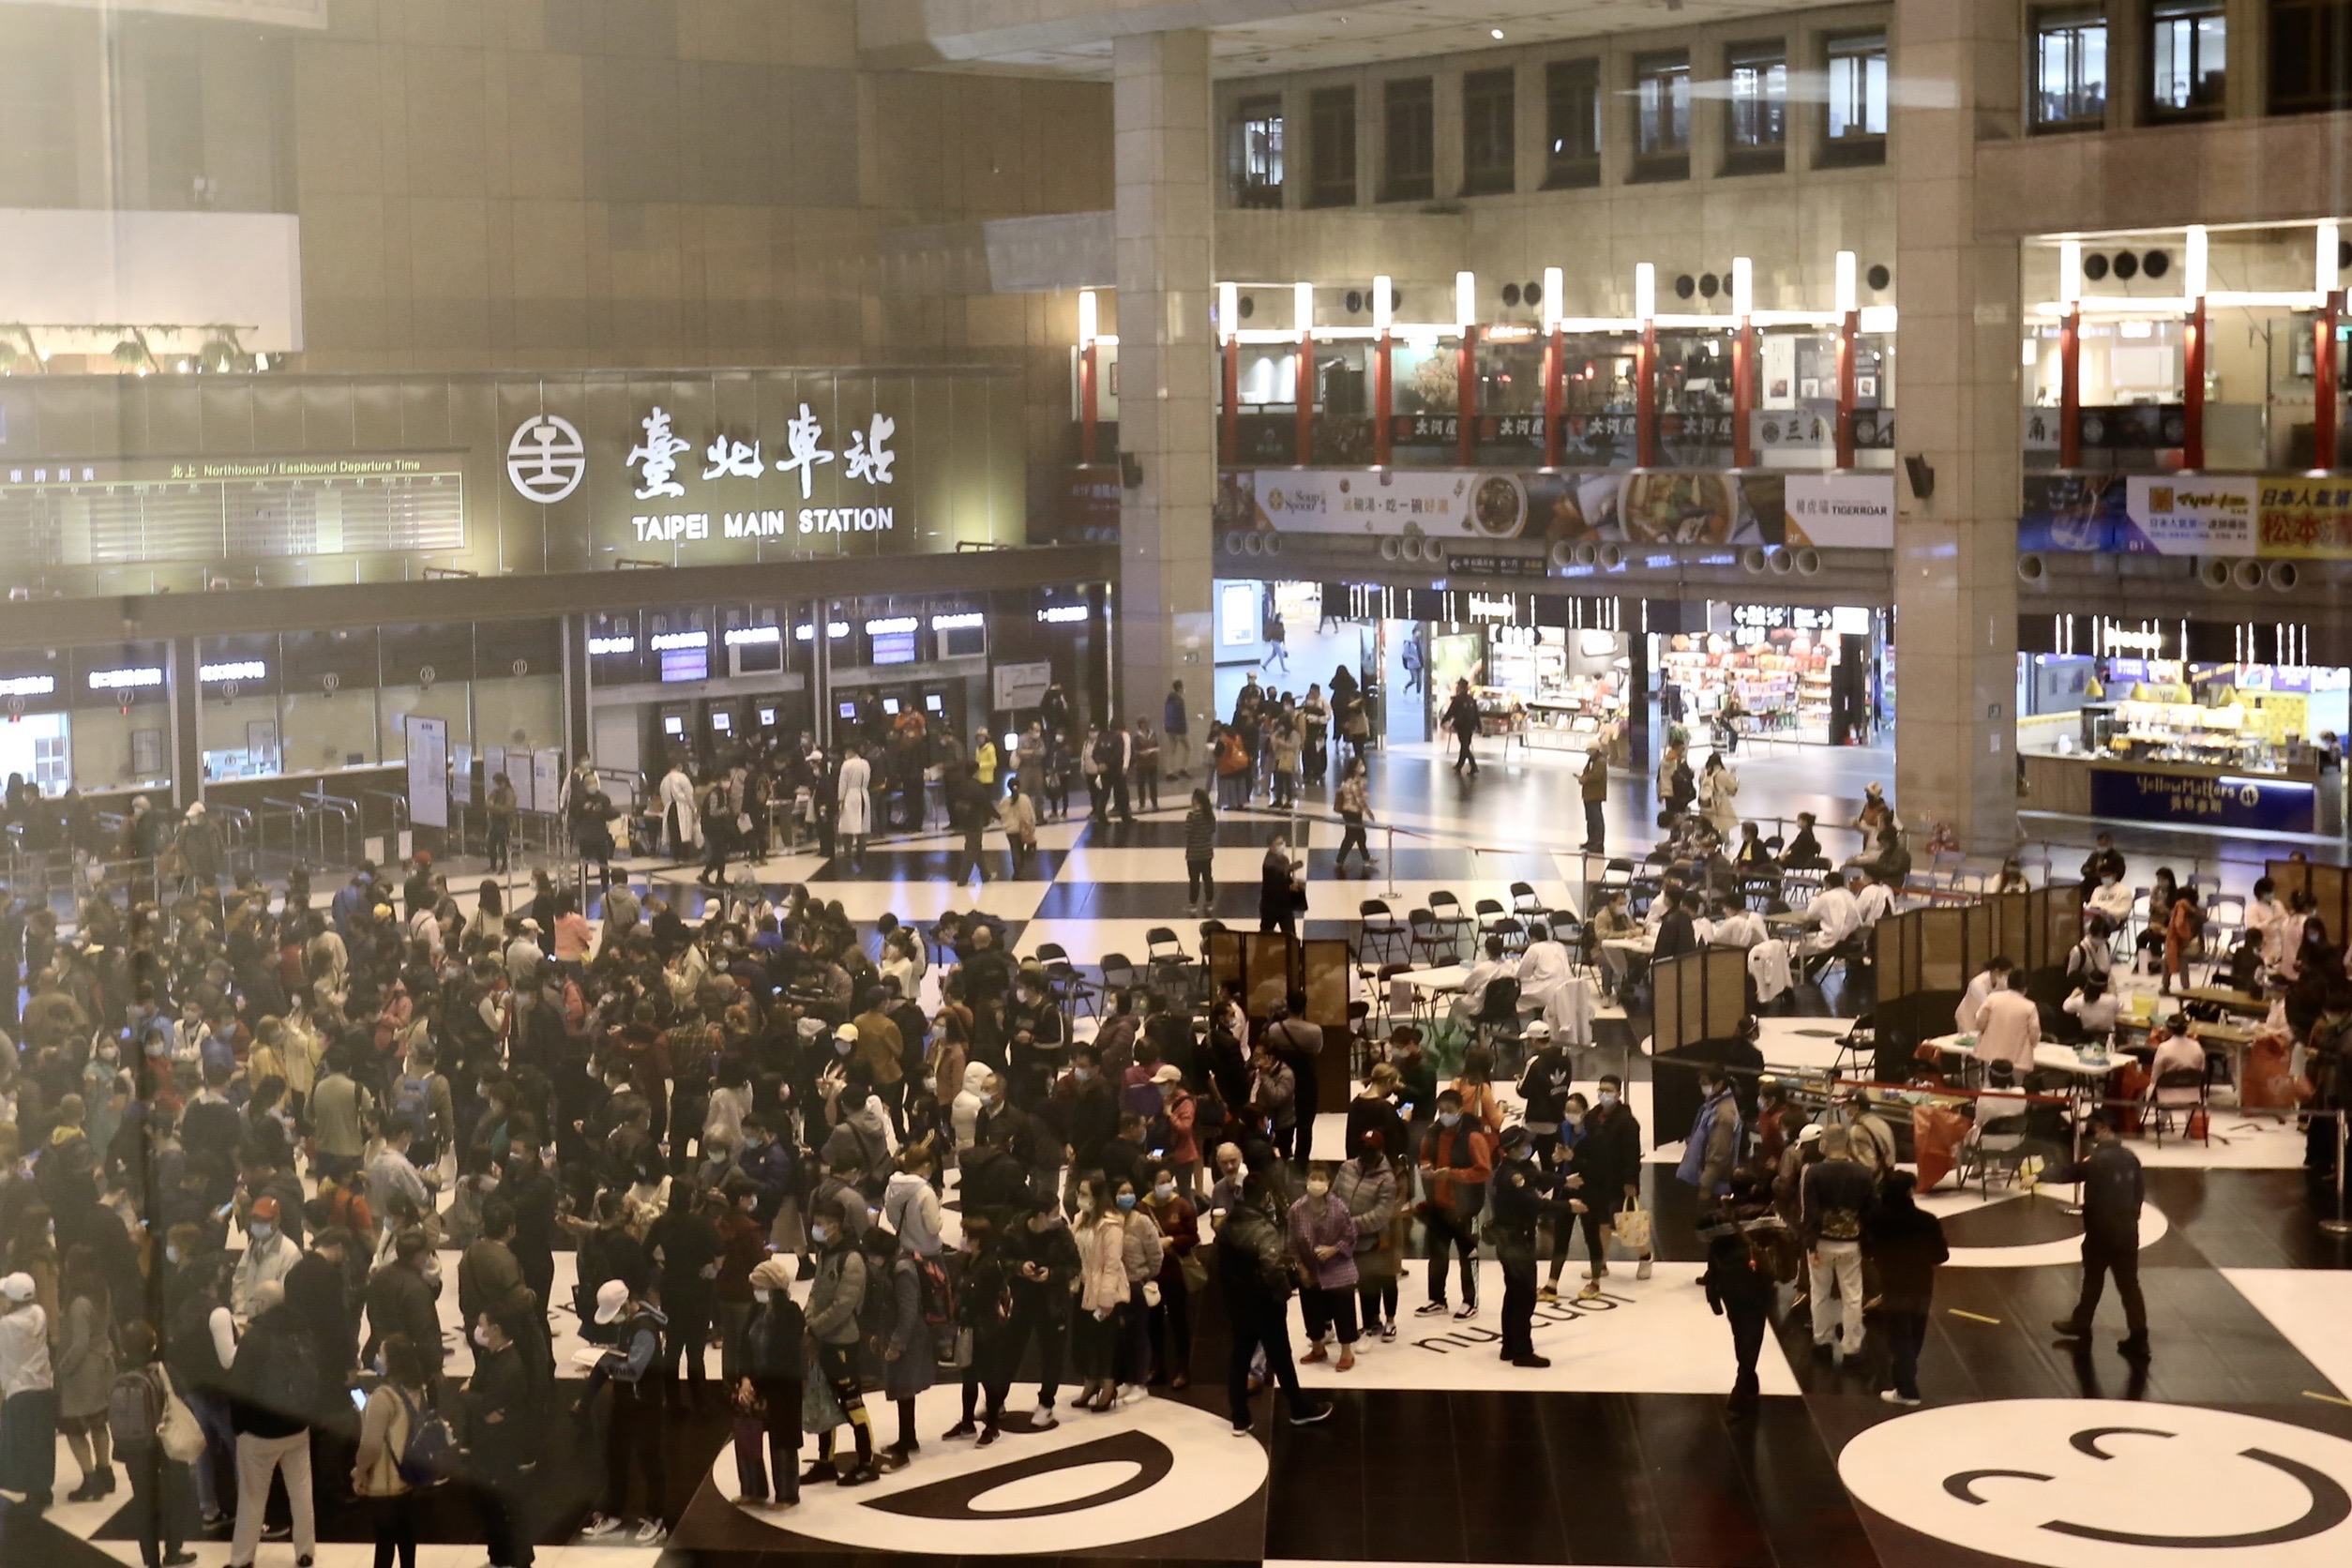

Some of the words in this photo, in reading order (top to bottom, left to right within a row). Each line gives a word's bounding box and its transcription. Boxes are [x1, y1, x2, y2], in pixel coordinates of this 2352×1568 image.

[626, 402, 895, 500] 臺北車站
[204, 462, 270, 476] Northbound
[279, 460, 337, 474] Eastbound
[339, 459, 392, 474] Departure
[395, 458, 421, 471] Time
[631, 513, 710, 542] TAIPEI
[722, 509, 786, 538] MAIN
[797, 506, 894, 535] STATION
[1832, 505, 1888, 516] TIGERROAR
